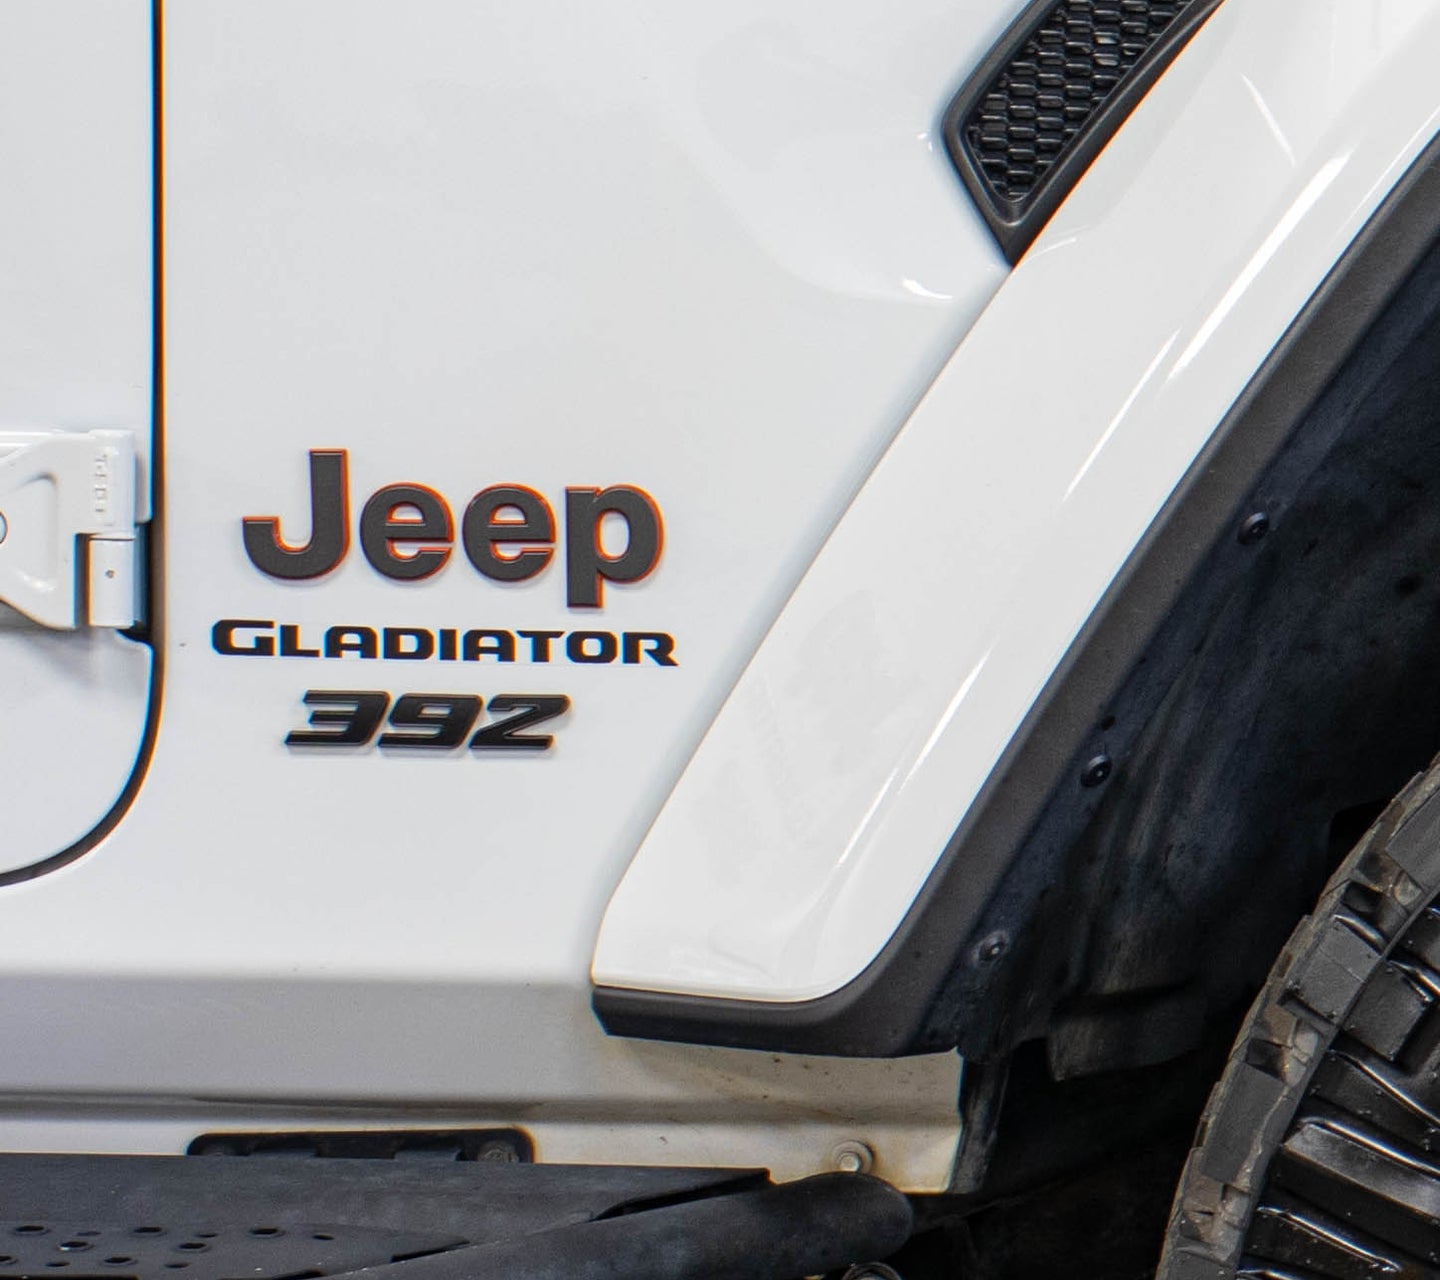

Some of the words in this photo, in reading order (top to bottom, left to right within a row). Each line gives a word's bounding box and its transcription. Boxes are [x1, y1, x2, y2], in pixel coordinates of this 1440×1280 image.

[243, 448, 666, 609] Jeep
[211, 619, 680, 667] GLADIATOR
[284, 689, 570, 751] 392
